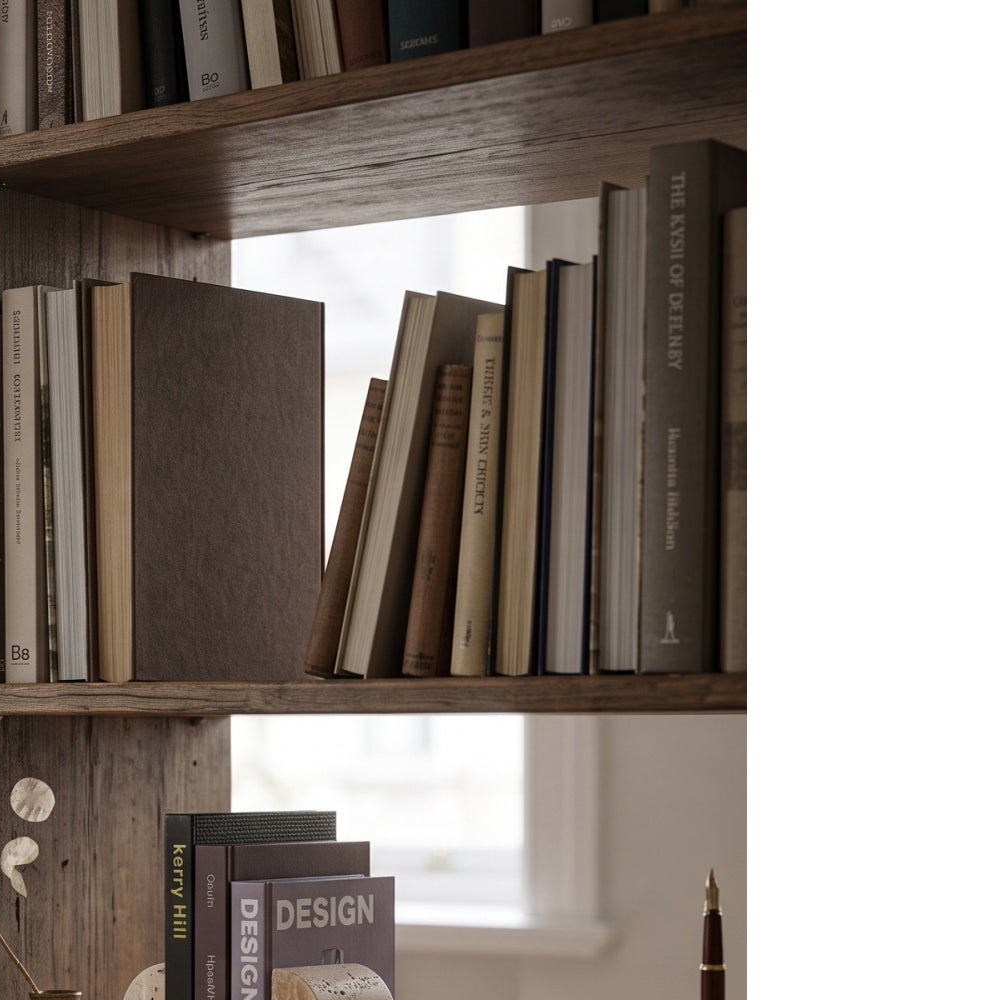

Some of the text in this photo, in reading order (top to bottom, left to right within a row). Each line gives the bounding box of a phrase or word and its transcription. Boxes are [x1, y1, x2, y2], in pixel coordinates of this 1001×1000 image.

[670, 171, 685, 210] THE
[669, 263, 684, 288] OF
[173, 904, 187, 939] Hill
[276, 894, 374, 931] DESIGN
